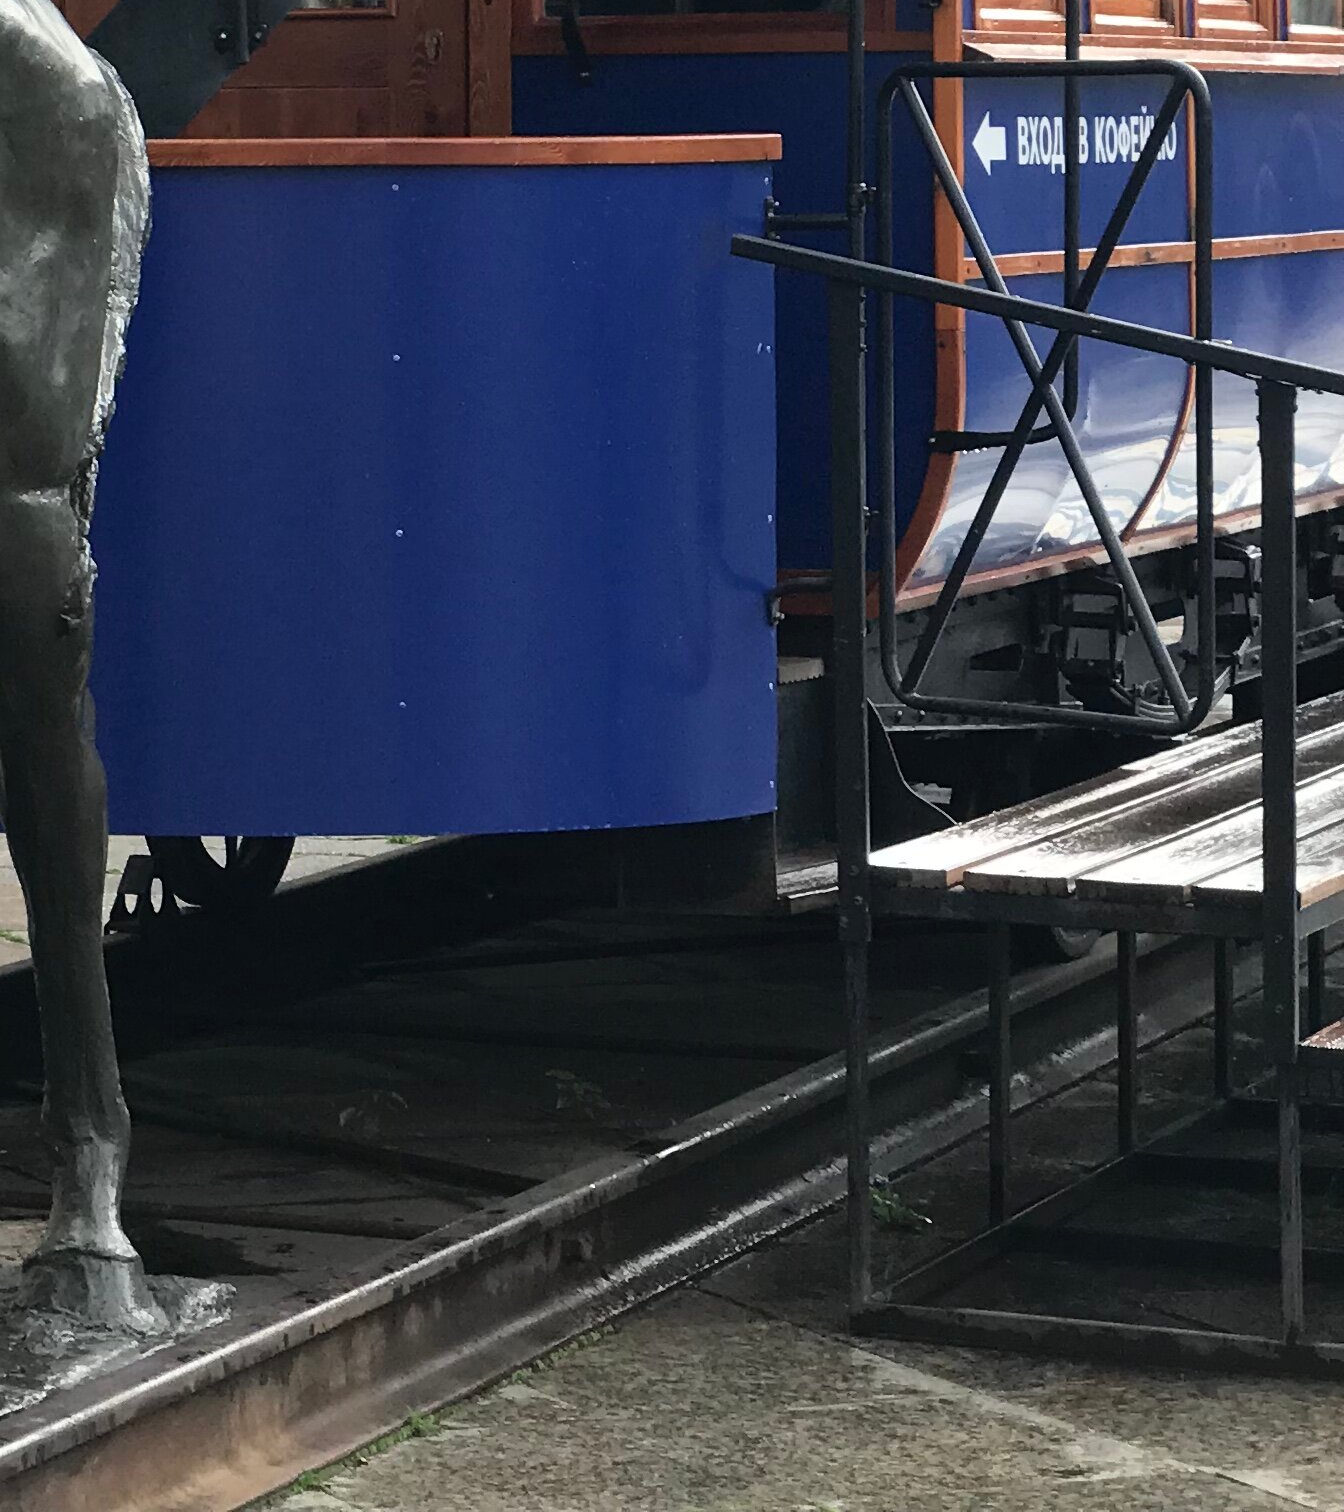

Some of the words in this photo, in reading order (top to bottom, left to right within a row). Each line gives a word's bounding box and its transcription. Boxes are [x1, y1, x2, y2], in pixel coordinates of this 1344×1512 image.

[1017, 116, 1065, 174] ВХОД
[1079, 117, 1089, 164] В
[1095, 105, 1177, 164] КОФЕЙЮ
